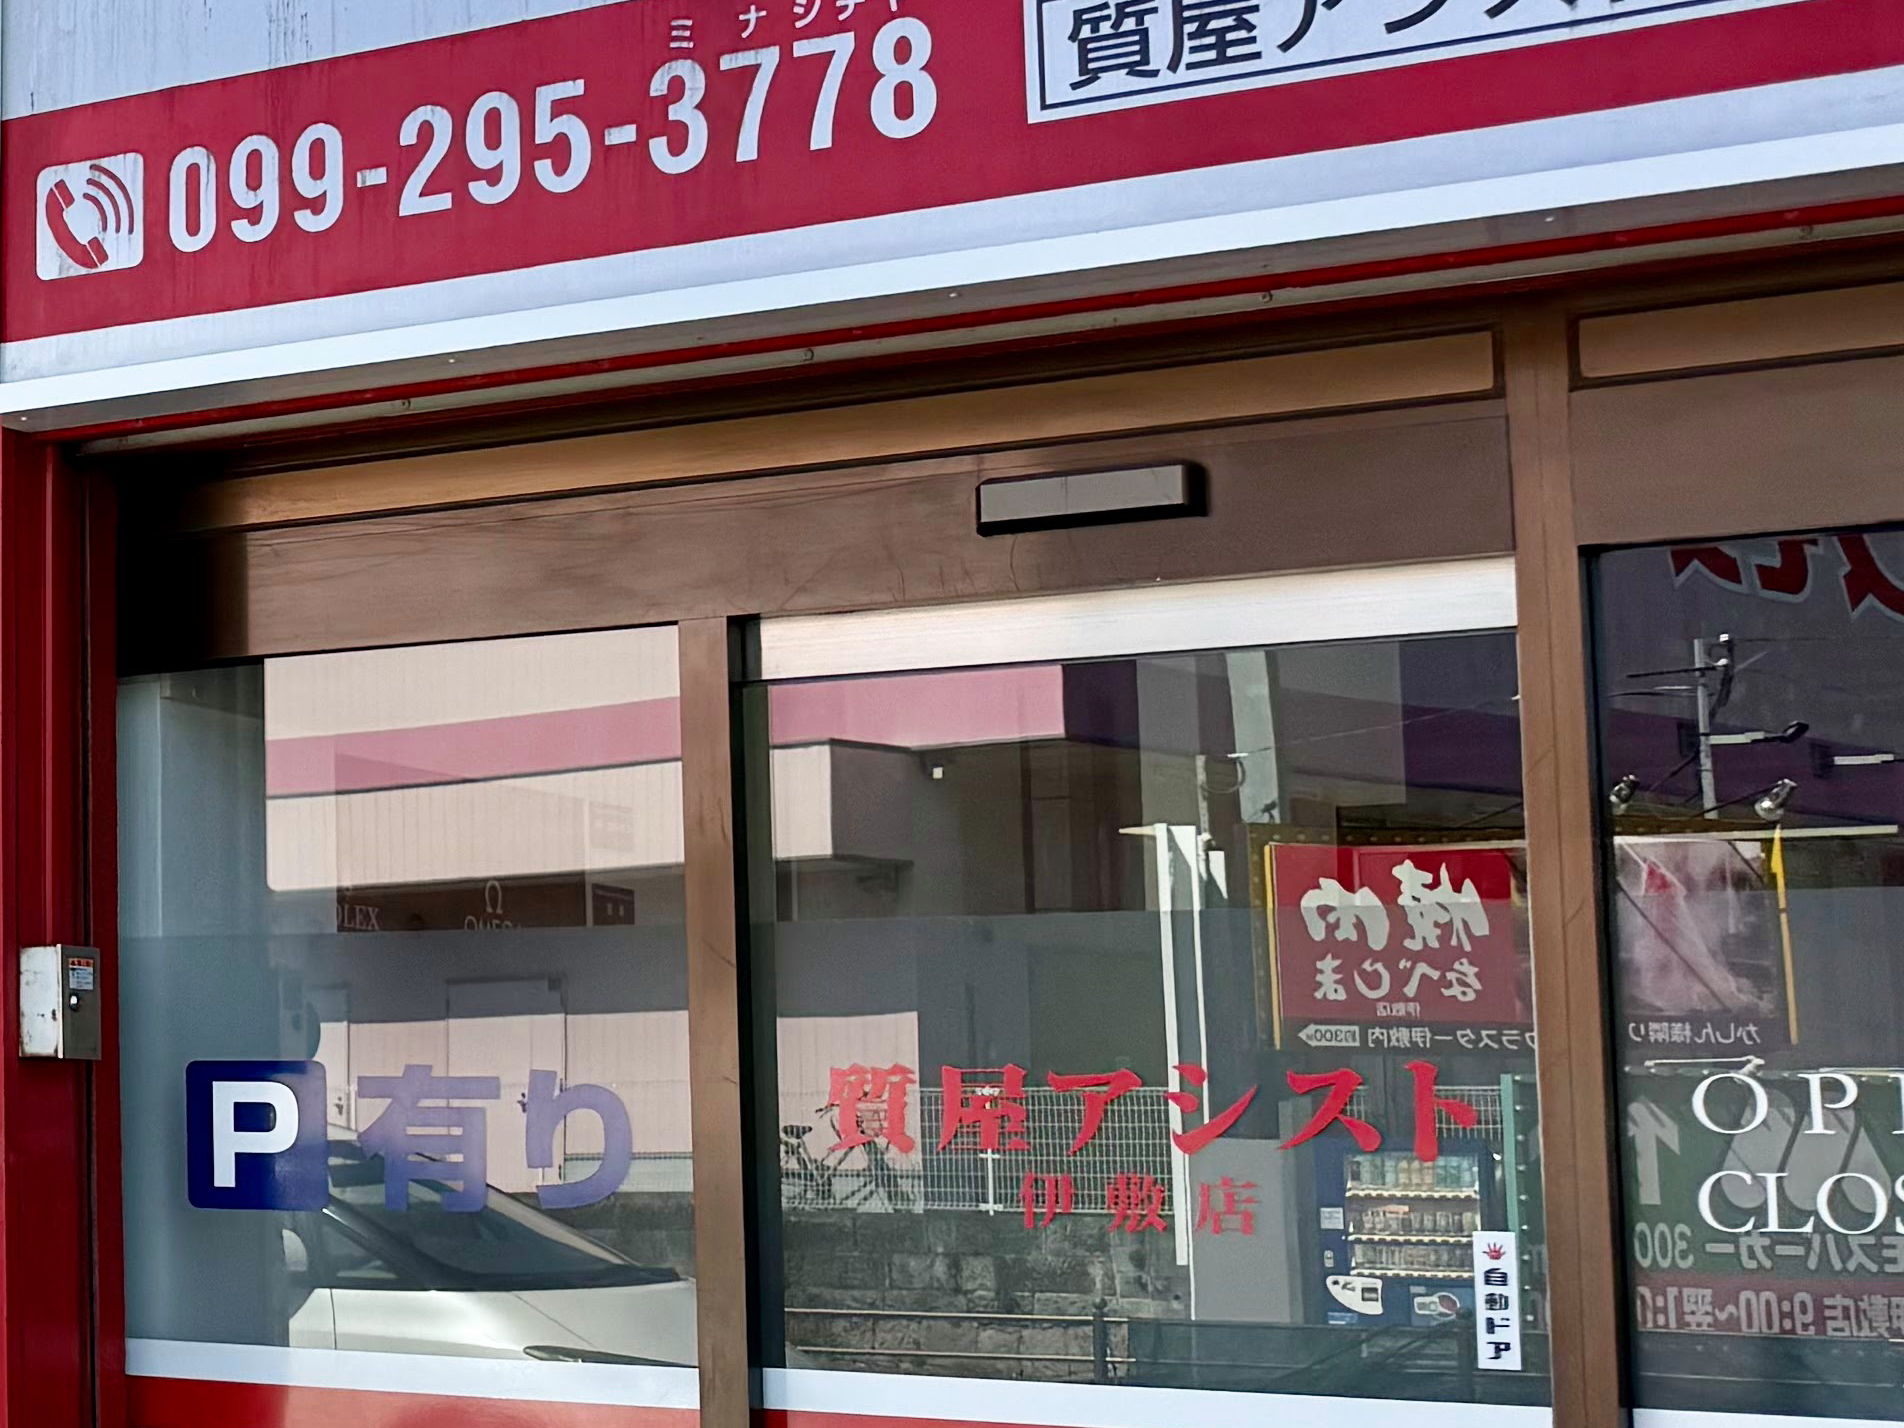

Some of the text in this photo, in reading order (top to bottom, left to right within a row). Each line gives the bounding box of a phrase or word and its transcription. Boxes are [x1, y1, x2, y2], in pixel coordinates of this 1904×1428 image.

[167, 17, 938, 254] 099-295-3778
[212, 1064, 633, 1213] P 有り
[829, 1058, 1479, 1164] 質屋アシスト
[1691, 1072, 1904, 1136] OP
[1019, 1172, 1260, 1236] 伊敷店
[1697, 1170, 1904, 1235] CLO
